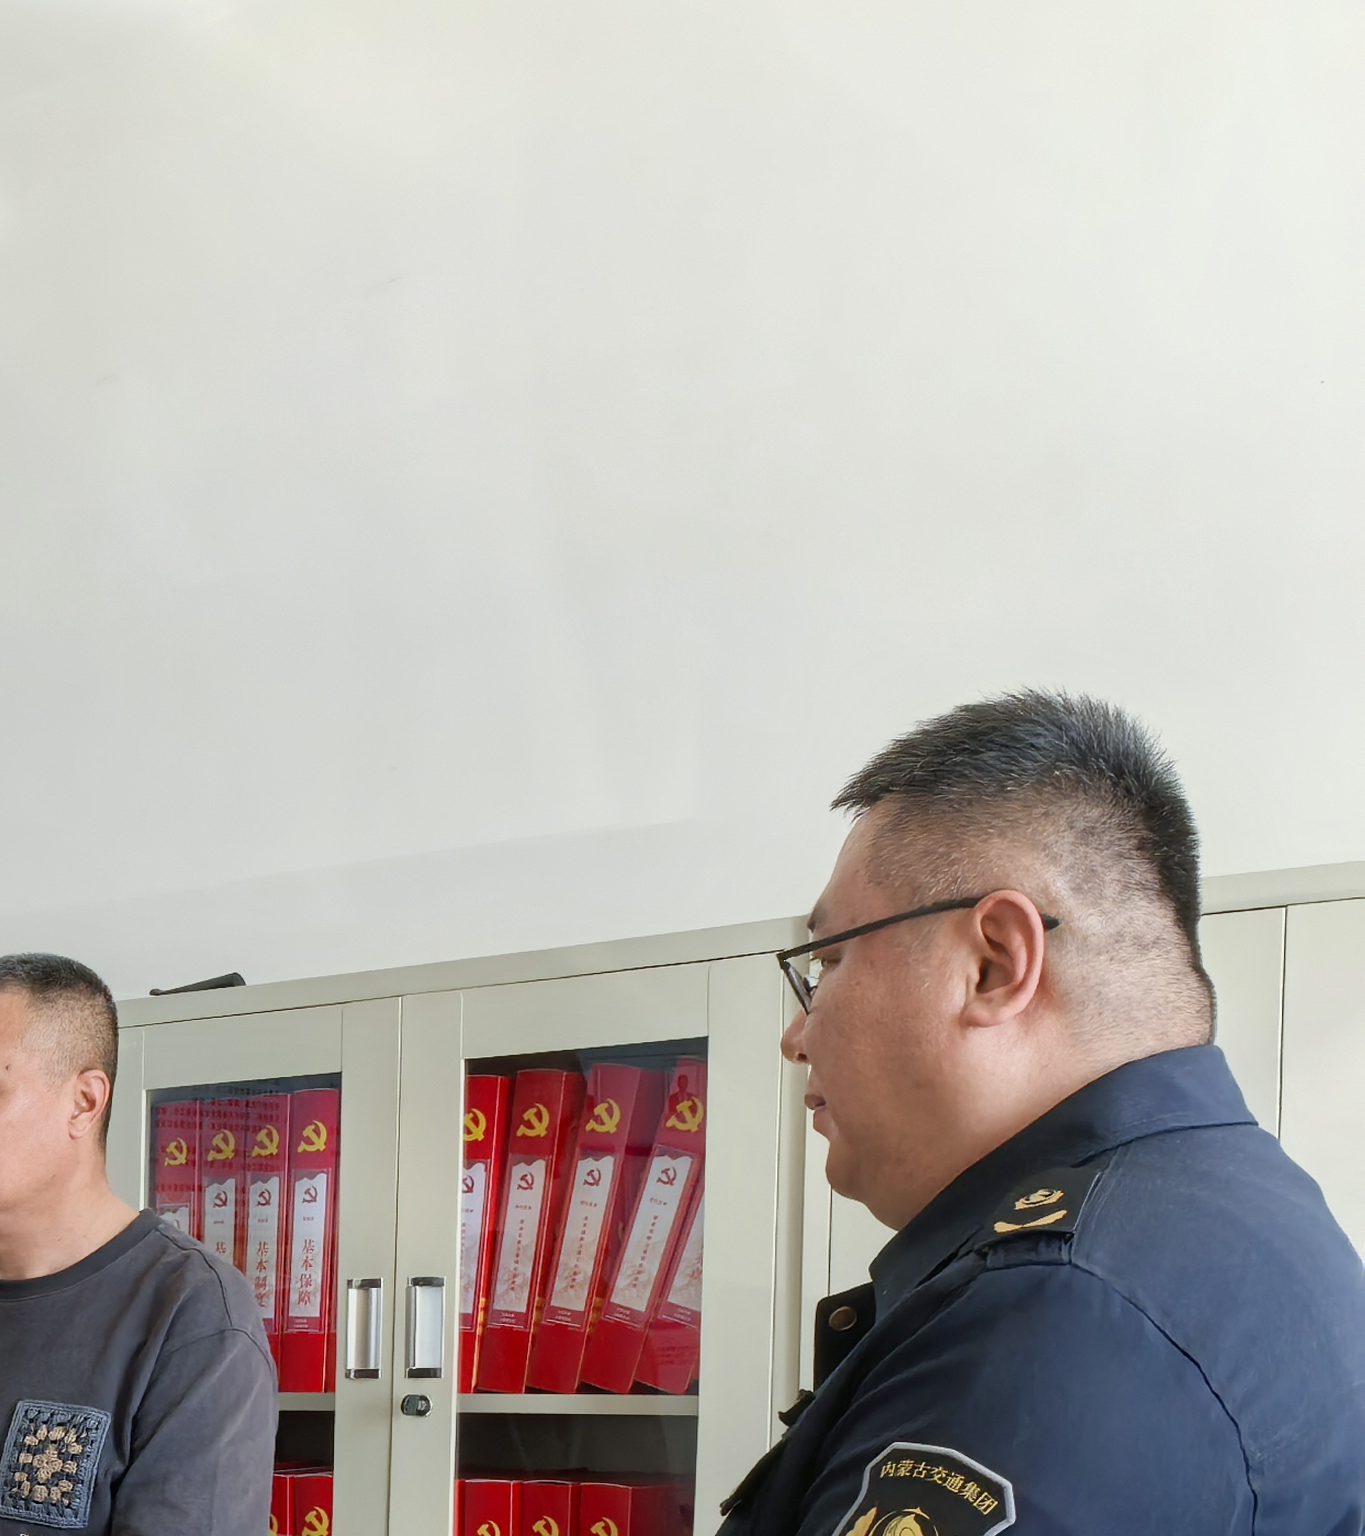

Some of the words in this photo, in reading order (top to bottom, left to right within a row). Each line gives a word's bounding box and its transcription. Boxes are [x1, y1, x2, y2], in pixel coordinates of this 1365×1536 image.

[879, 1458, 999, 1516] 内蒙古交通集团
